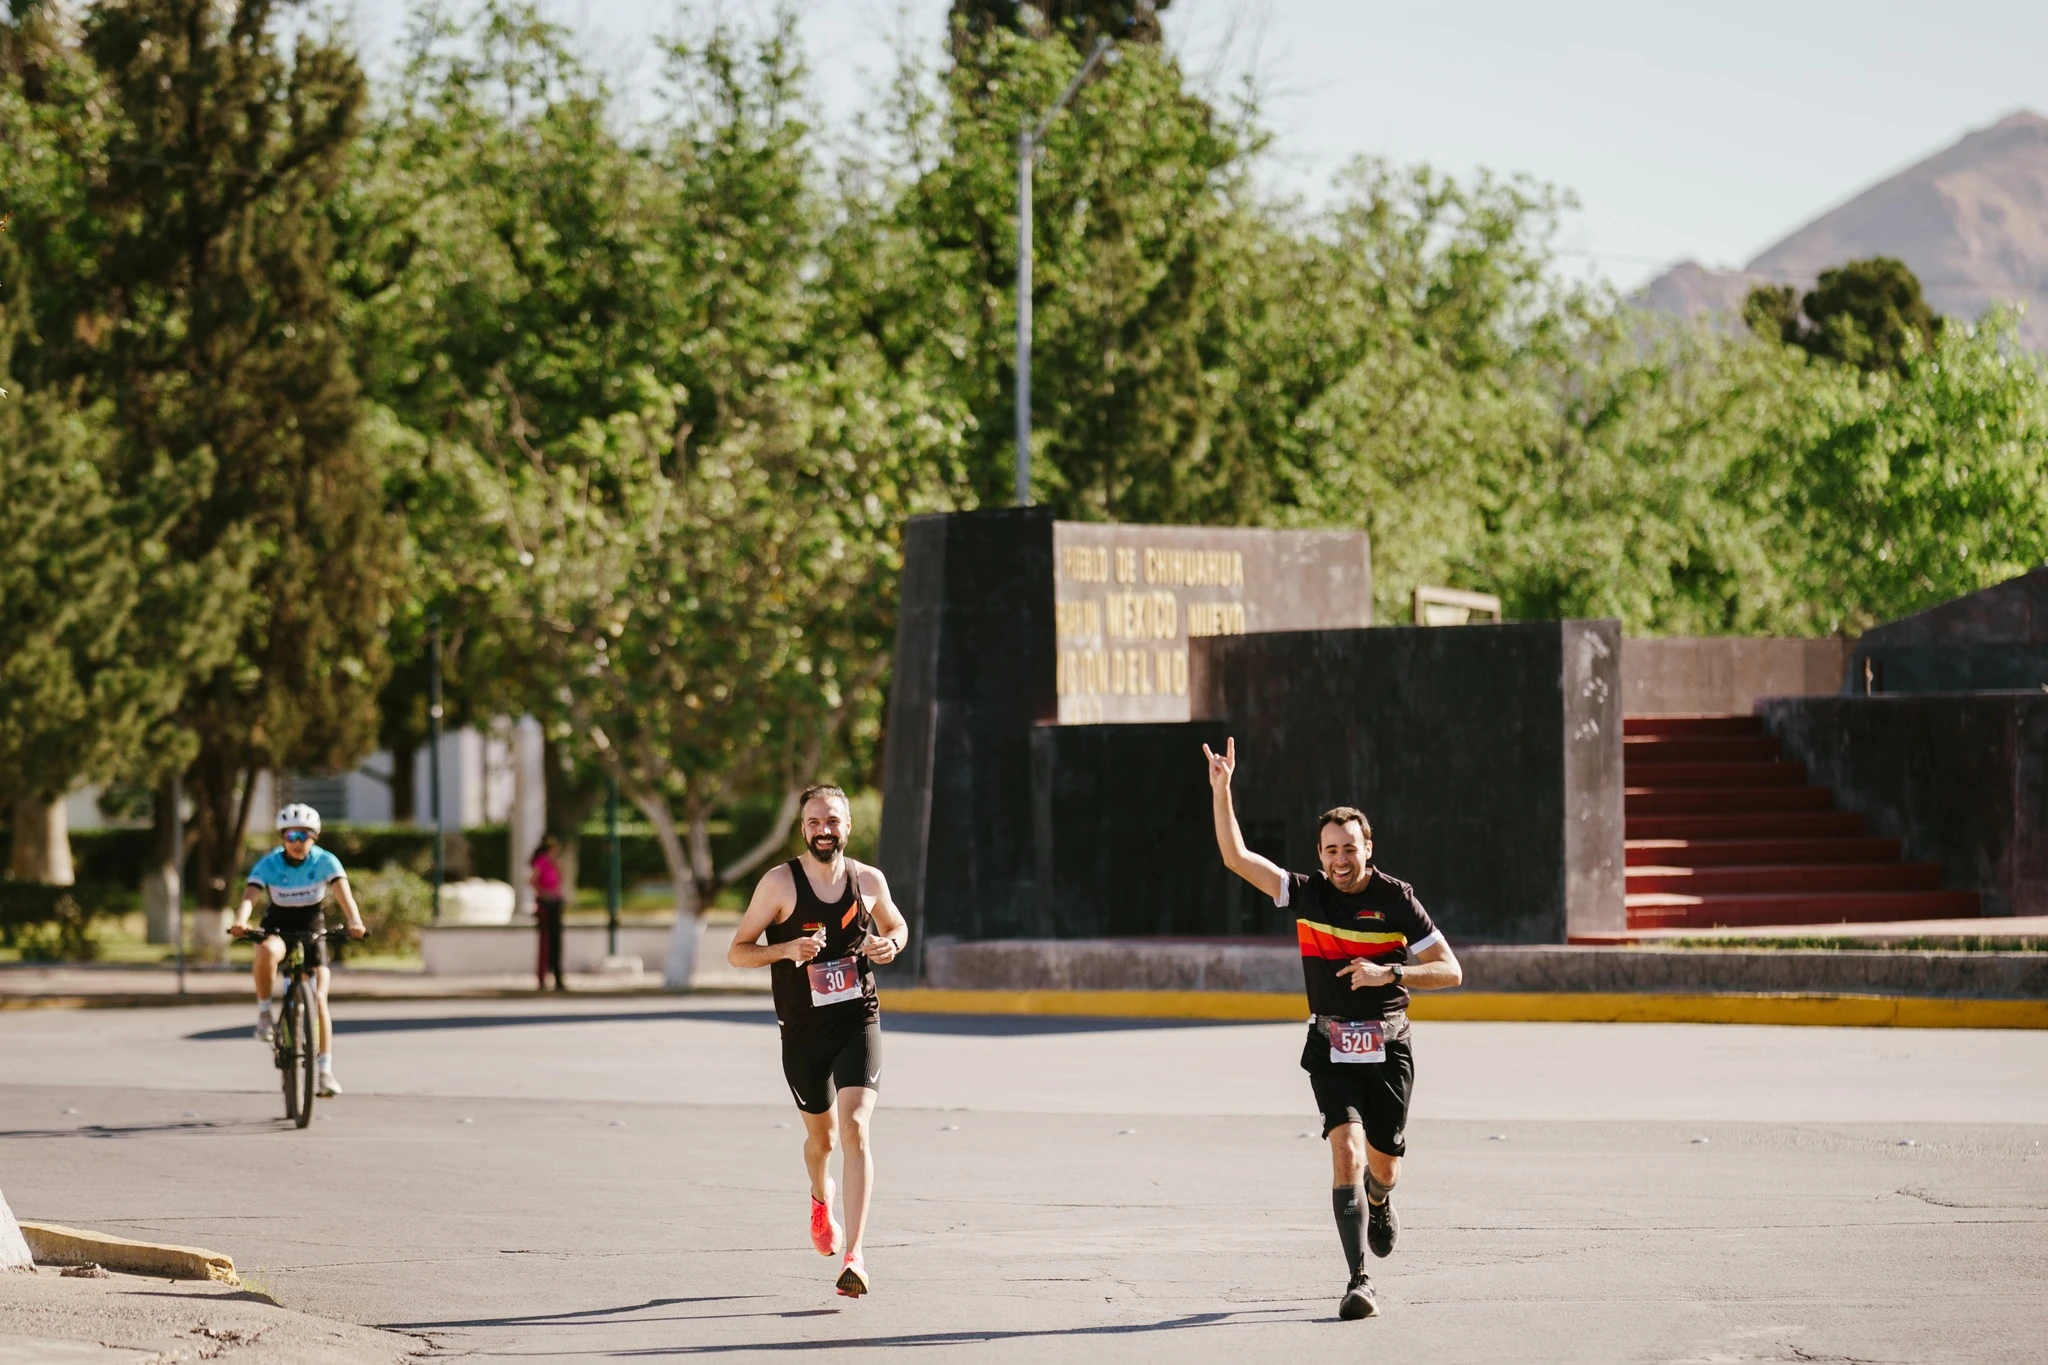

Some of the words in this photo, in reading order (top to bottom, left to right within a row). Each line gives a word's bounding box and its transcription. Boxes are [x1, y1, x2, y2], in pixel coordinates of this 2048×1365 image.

[1063, 546, 1108, 583] PUEBLO
[1115, 546, 1136, 583] DE
[1144, 546, 1245, 586] CHIHUAHUA
[1187, 601, 1246, 637] NUEVO
[1111, 648, 1151, 696] DEL
[826, 971, 845, 991] 30
[1342, 1032, 1372, 1052] 520
